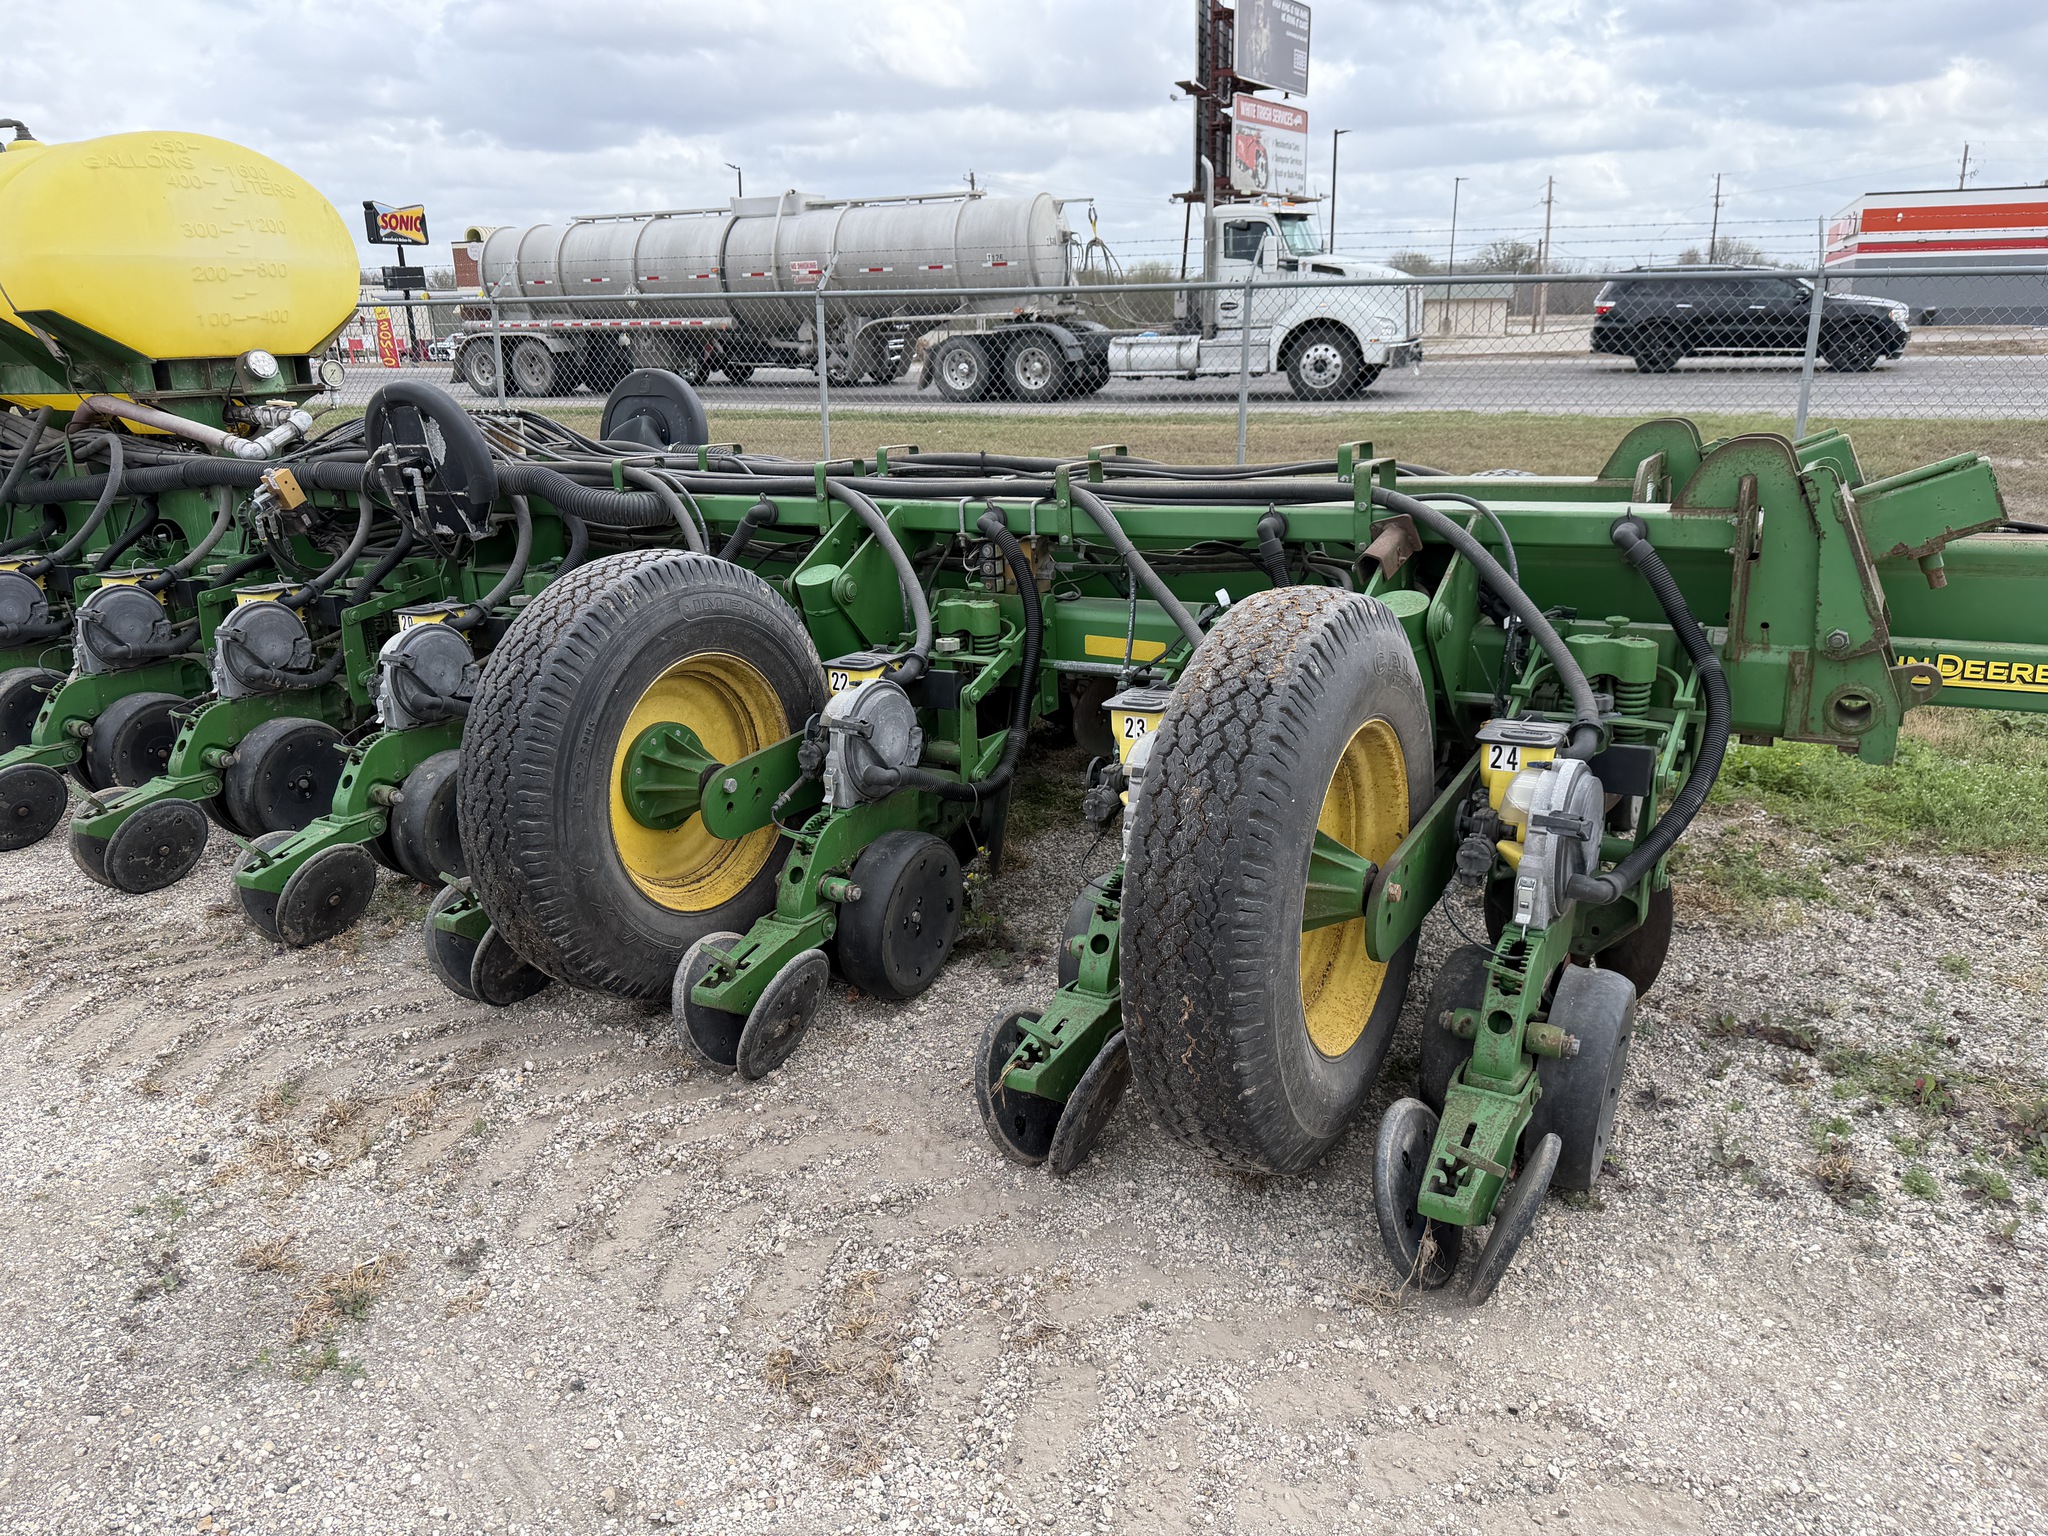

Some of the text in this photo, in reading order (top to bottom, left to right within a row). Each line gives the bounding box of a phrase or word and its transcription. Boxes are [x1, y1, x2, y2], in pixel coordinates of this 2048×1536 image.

[151, 139, 187, 153] 450
[81, 153, 195, 169] GALLONS
[225, 162, 269, 180] 1600
[166, 174, 203, 189] 400
[230, 178, 297, 198] LITERS
[181, 222, 219, 238] 300
[245, 217, 286, 234] 1200
[381, 213, 421, 232] SONIC
[192, 266, 229, 281] 200
[257, 262, 287, 278] 800
[196, 313, 231, 327] 100
[260, 309, 289, 324] 400
[1937, 654, 2048, 684] DEERE
[832, 672, 848, 690] 22
[1125, 717, 1145, 738] 23
[1490, 745, 1518, 771] 24
